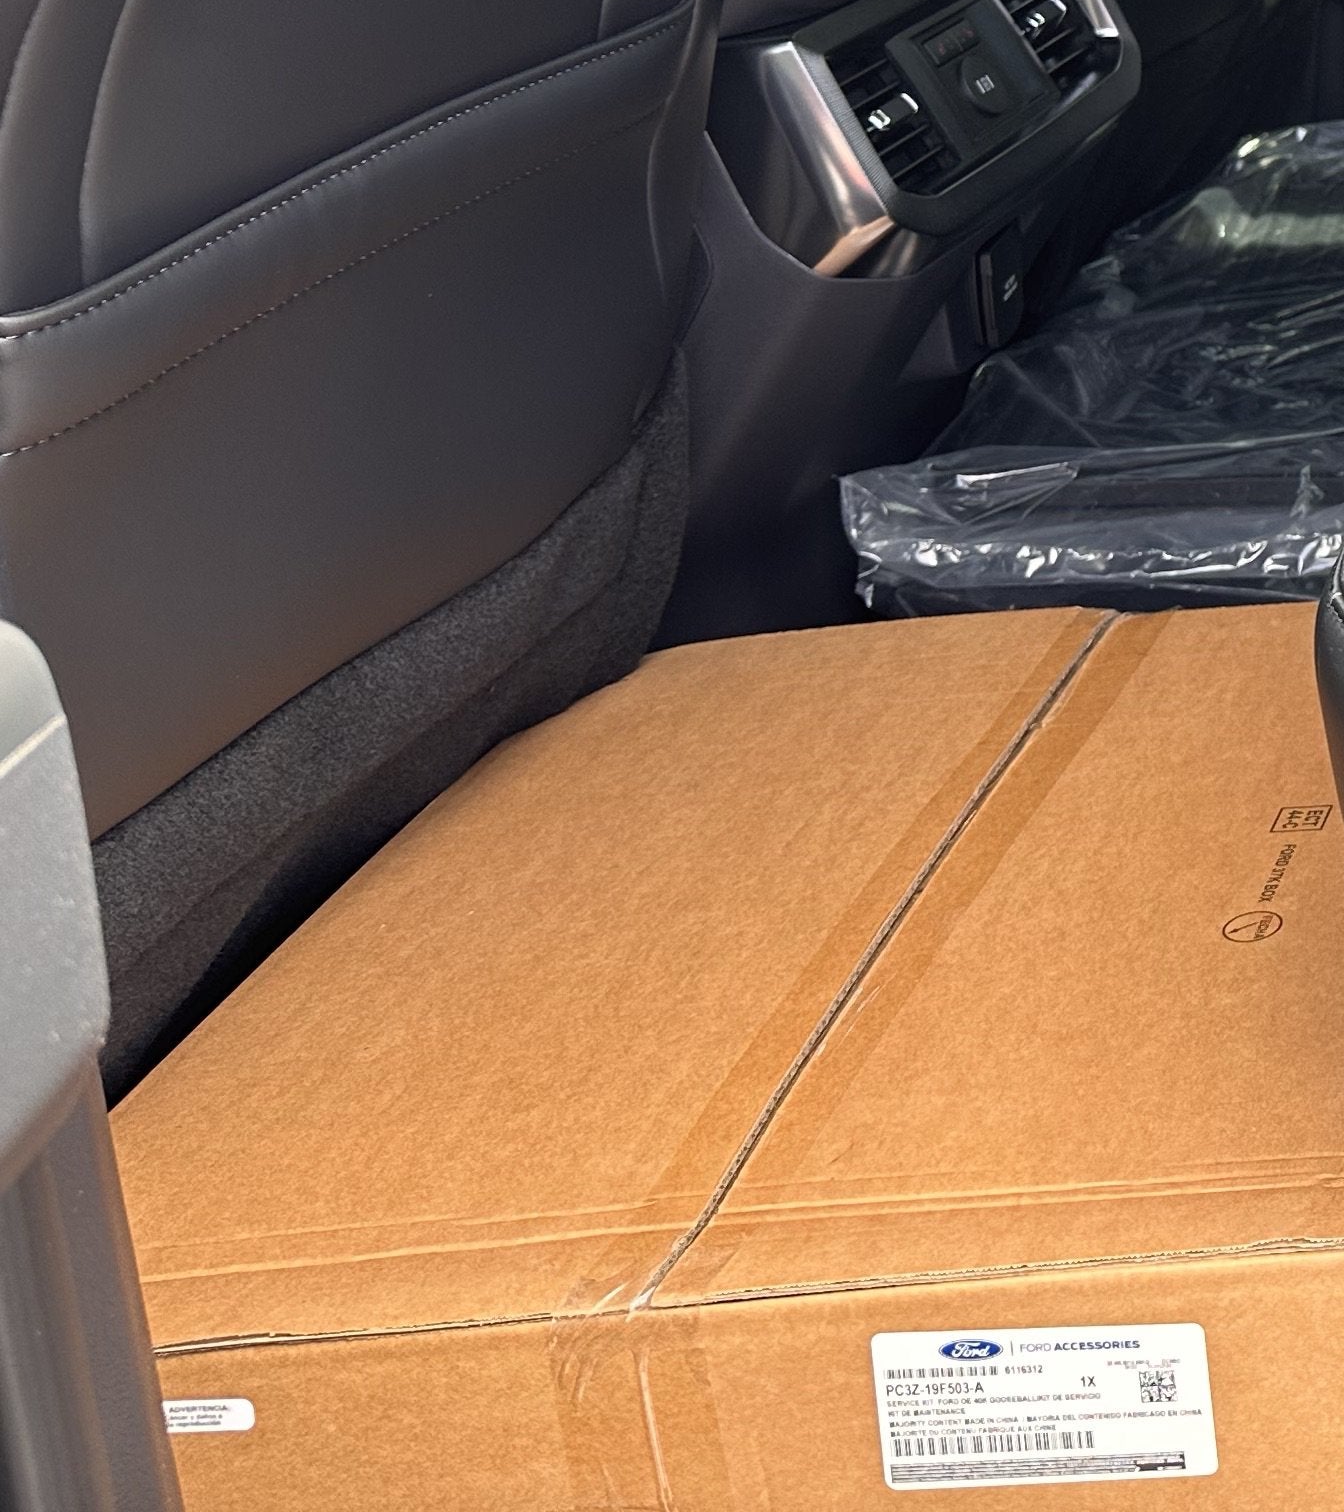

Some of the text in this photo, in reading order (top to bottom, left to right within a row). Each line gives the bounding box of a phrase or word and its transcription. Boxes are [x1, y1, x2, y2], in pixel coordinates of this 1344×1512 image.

[1302, 809, 1324, 827] ECT
[1275, 843, 1297, 867] FORD
[1258, 884, 1280, 903] BOX
[1019, 1339, 1141, 1353] FORD ACCESSORIES
[885, 1381, 985, 1397] PC3Z-19F503-A
[1080, 1375, 1097, 1388] 1X
